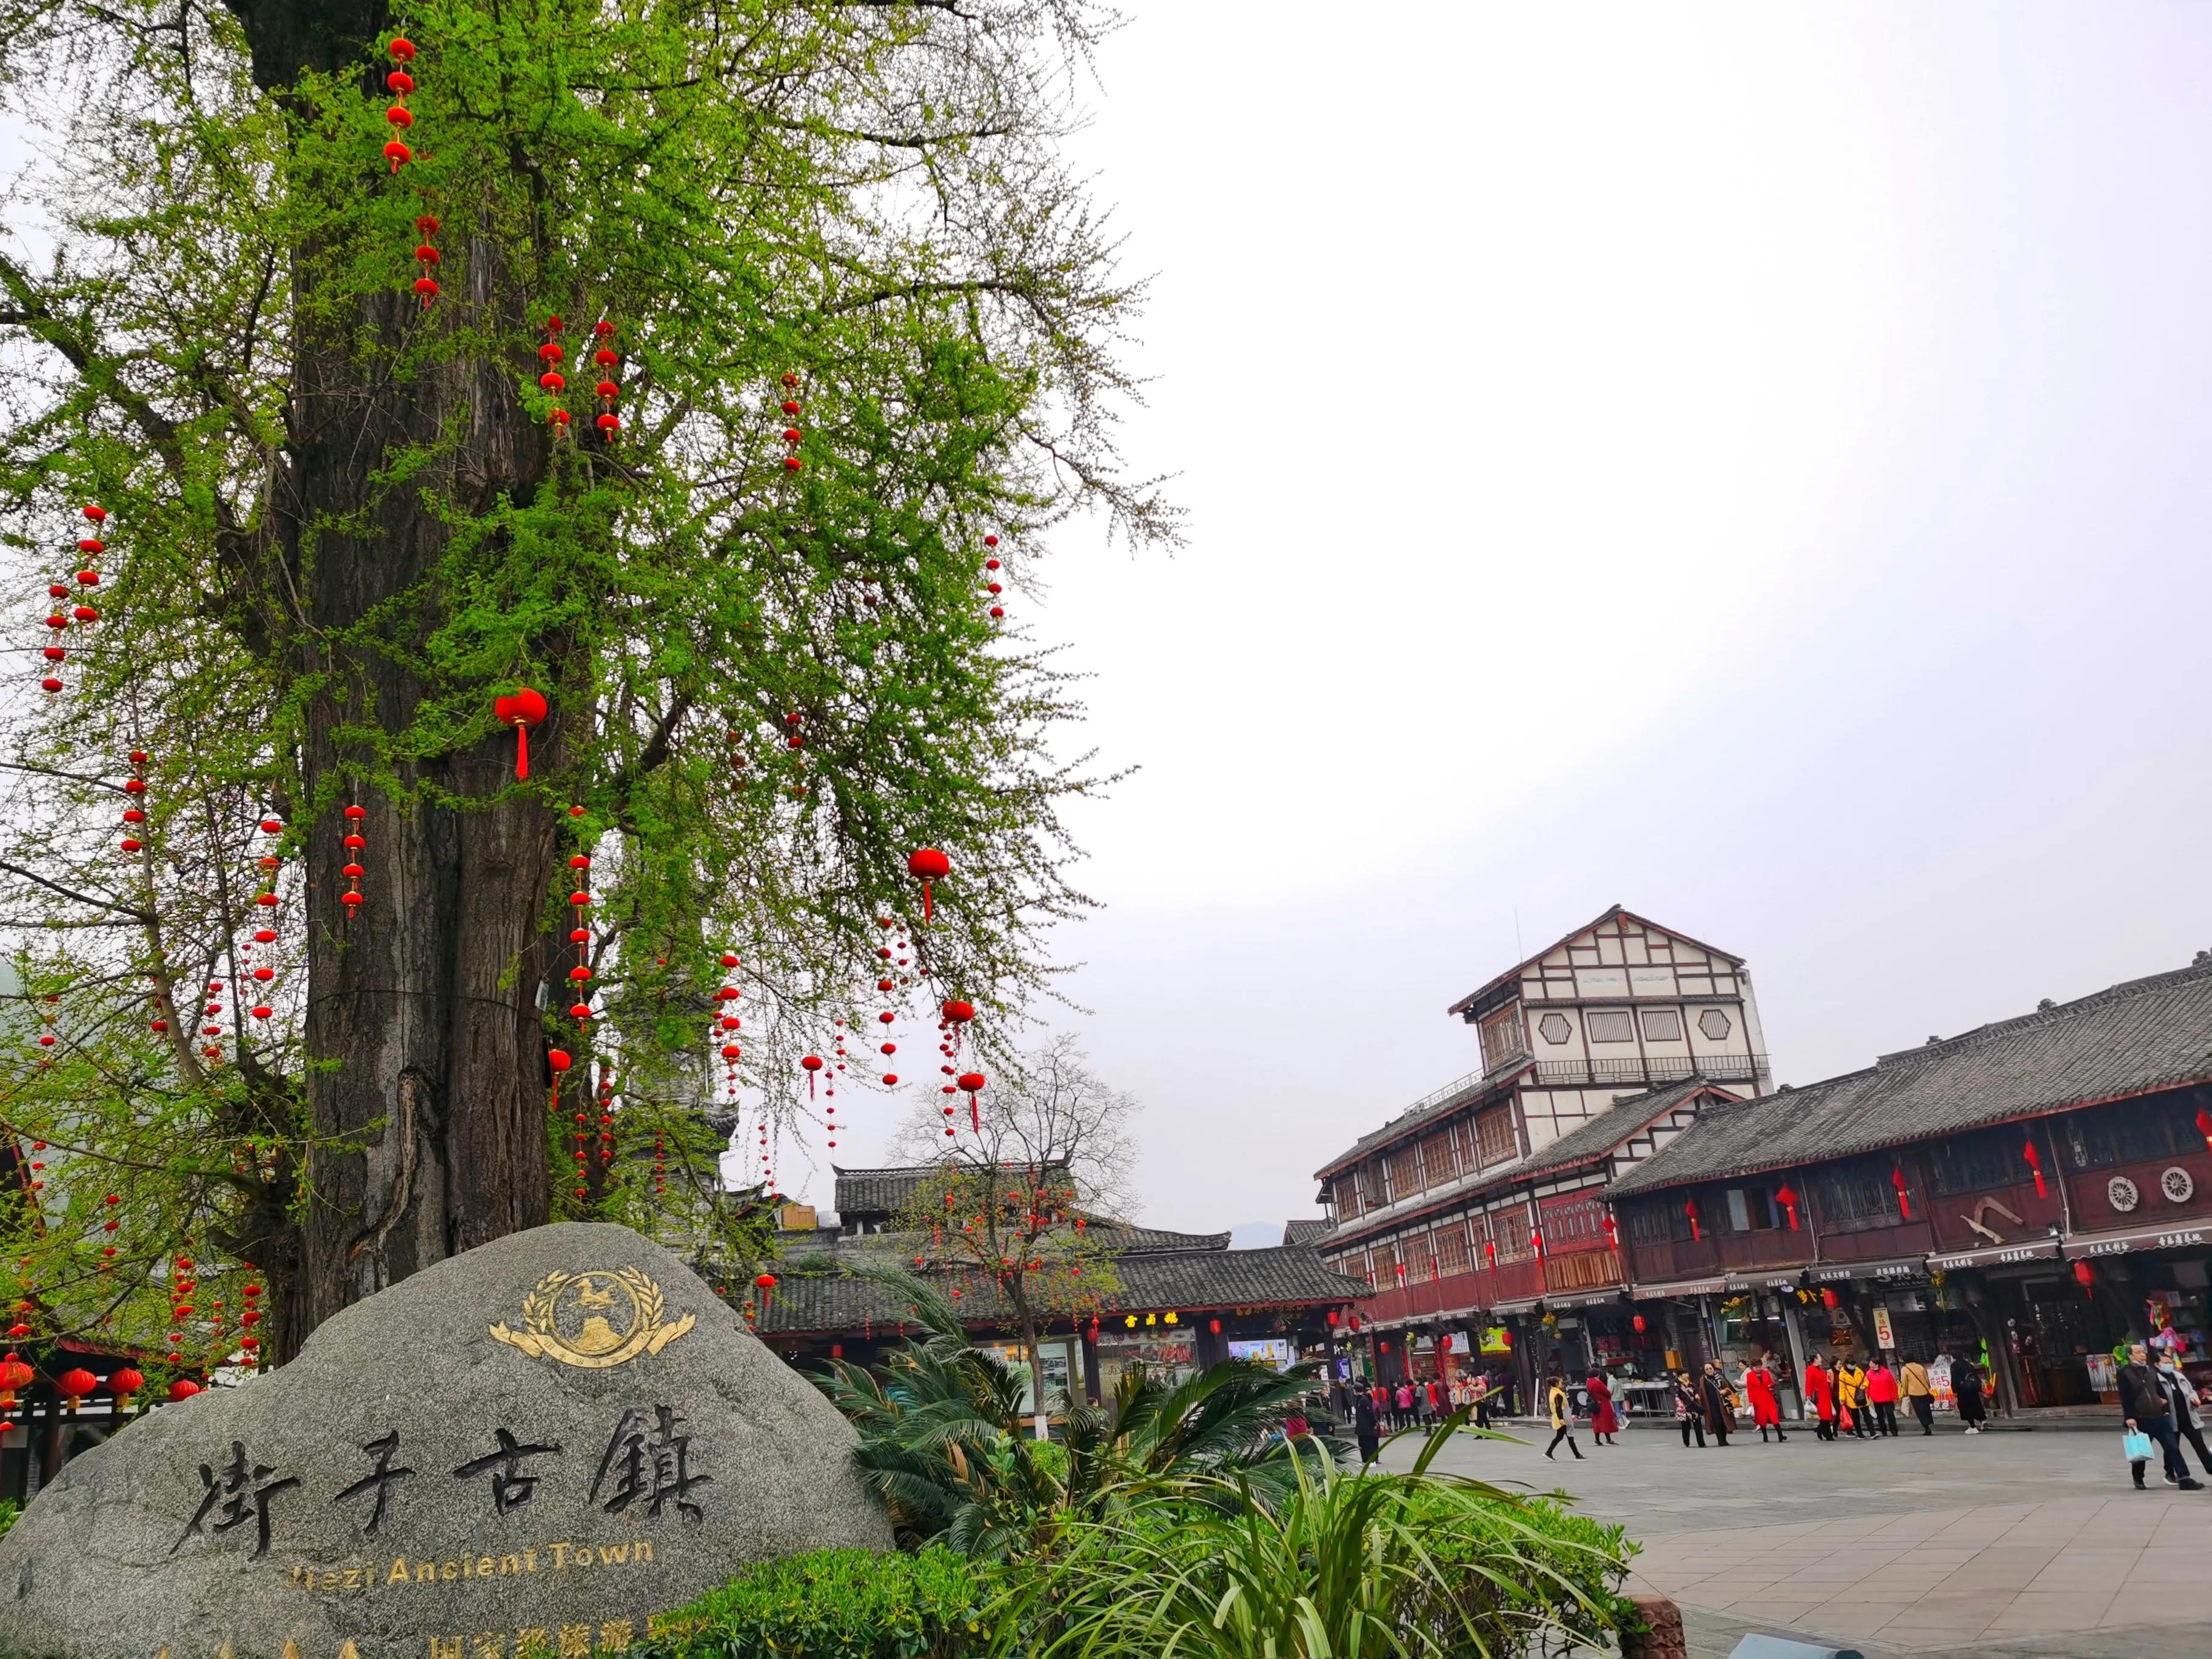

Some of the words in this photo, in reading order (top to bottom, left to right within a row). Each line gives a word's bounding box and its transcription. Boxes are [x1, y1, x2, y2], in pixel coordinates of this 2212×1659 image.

[387, 1548, 538, 1586] Ancient
[548, 1539, 655, 1570] Town
[429, 1614, 673, 1659] 国家级旅游
